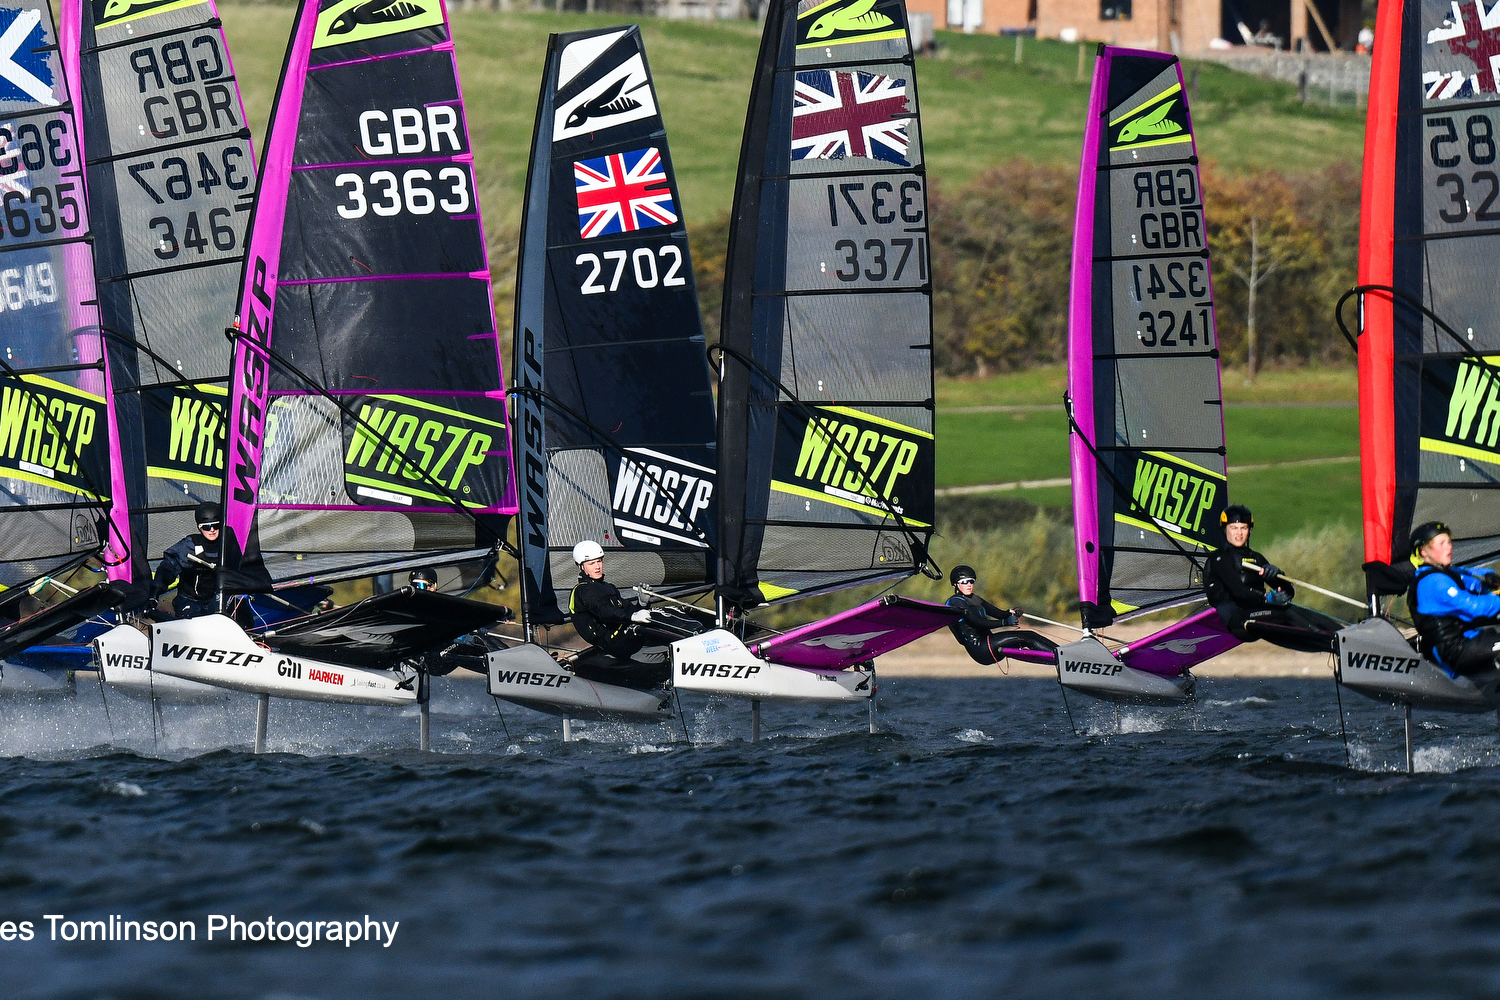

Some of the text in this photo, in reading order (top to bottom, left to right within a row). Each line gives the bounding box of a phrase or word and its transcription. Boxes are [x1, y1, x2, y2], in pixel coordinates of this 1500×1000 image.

[143, 84, 238, 139] GBR
[359, 105, 461, 155] GBR
[335, 167, 470, 219] 3363
[1140, 211, 1202, 249] GBR
[575, 244, 686, 295] 2702
[835, 237, 926, 282] 3371
[1138, 309, 1210, 347] 3241
[233, 255, 272, 506] WASZP
[345, 404, 493, 491] WASZP
[524, 326, 546, 549] WASZP
[794, 417, 919, 501] WASZP
[612, 456, 714, 532] WASZP
[1130, 458, 1217, 532] WASZP
[161, 642, 264, 667] WASZP
[278, 658, 302, 679] Gill
[308, 668, 344, 686] HARKEN
[681, 662, 761, 679] WASZP
[1065, 660, 1123, 677] WASZP
[1347, 651, 1421, 674] WASZP
[498, 670, 571, 688] WASZP
